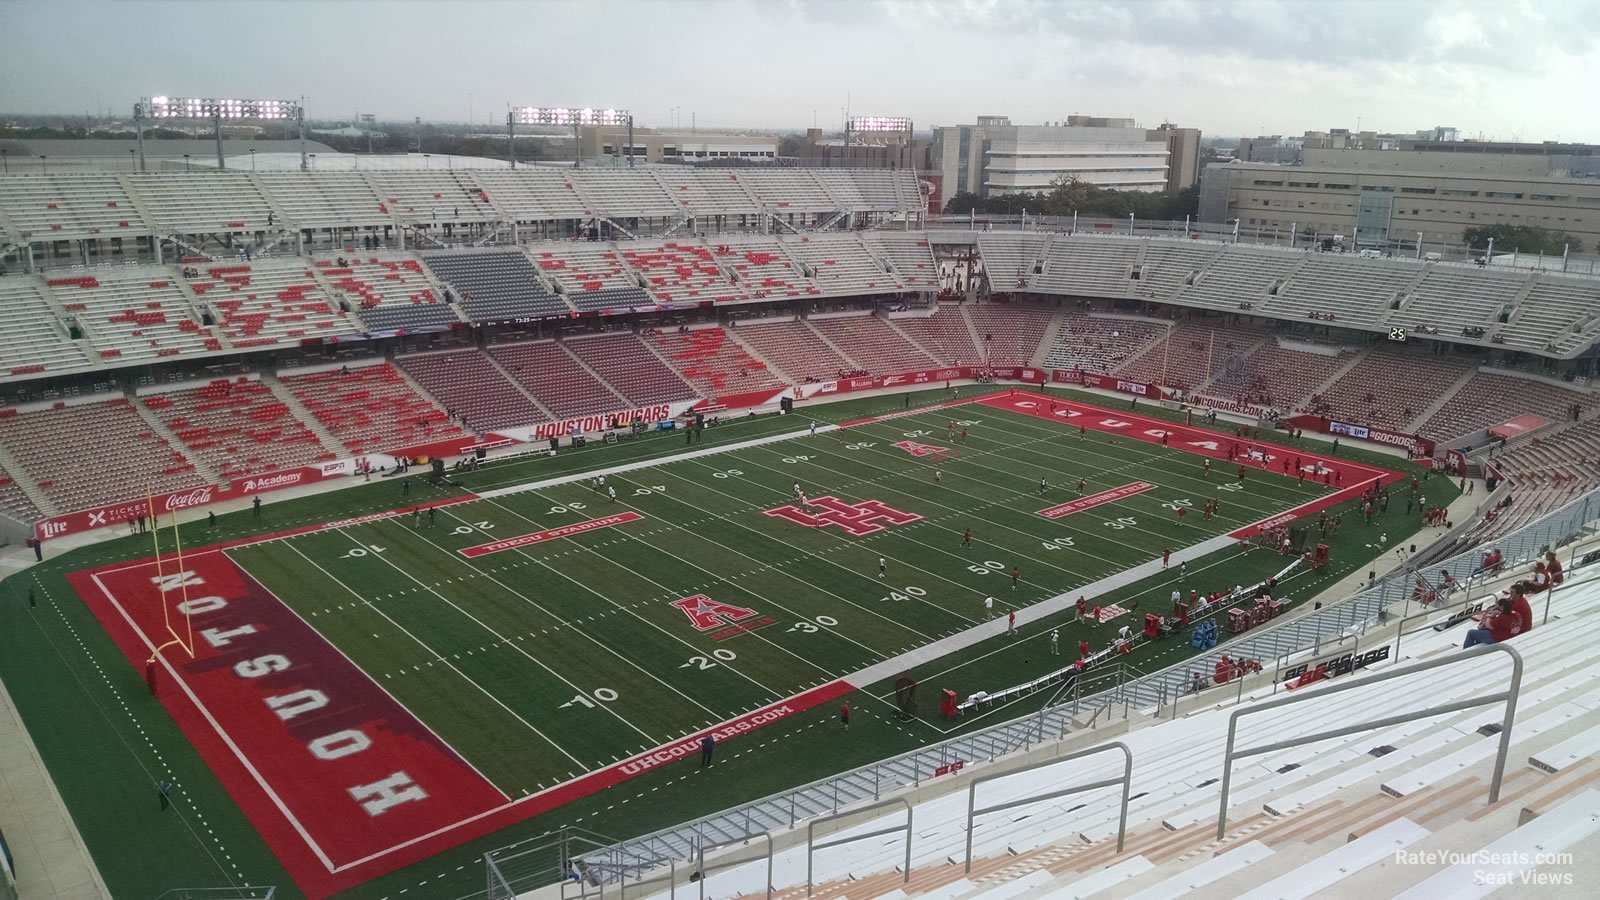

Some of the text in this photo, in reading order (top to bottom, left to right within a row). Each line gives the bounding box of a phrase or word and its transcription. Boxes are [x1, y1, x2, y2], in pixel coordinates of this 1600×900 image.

[1390, 327, 1405, 339] 25
[606, 404, 670, 430] COUGARS
[536, 415, 604, 440] HOUSTON
[1369, 430, 1416, 447] #GOCOOGS
[324, 462, 345, 471] ESPN
[712, 469, 744, 479] 50
[257, 472, 303, 487] Academy
[165, 486, 213, 511] Coca-Cola
[636, 485, 666, 496] 40
[109, 503, 148, 517] TICKET
[550, 502, 587, 514] 30
[762, 495, 925, 536] UH
[40, 521, 68, 539] Lite
[456, 521, 494, 534] 20
[1104, 517, 1138, 530] 30
[482, 516, 624, 551] TDECU STADIUM
[348, 545, 387, 557] 10
[1042, 537, 1074, 551] 40
[967, 560, 1006, 576] 50
[887, 586, 927, 604] 40
[794, 615, 839, 634] 30
[688, 649, 737, 671] 20
[150, 570, 430, 817] HOUSTON
[569, 688, 619, 708] 10
[618, 704, 795, 776] UHCOUGARS.COM
